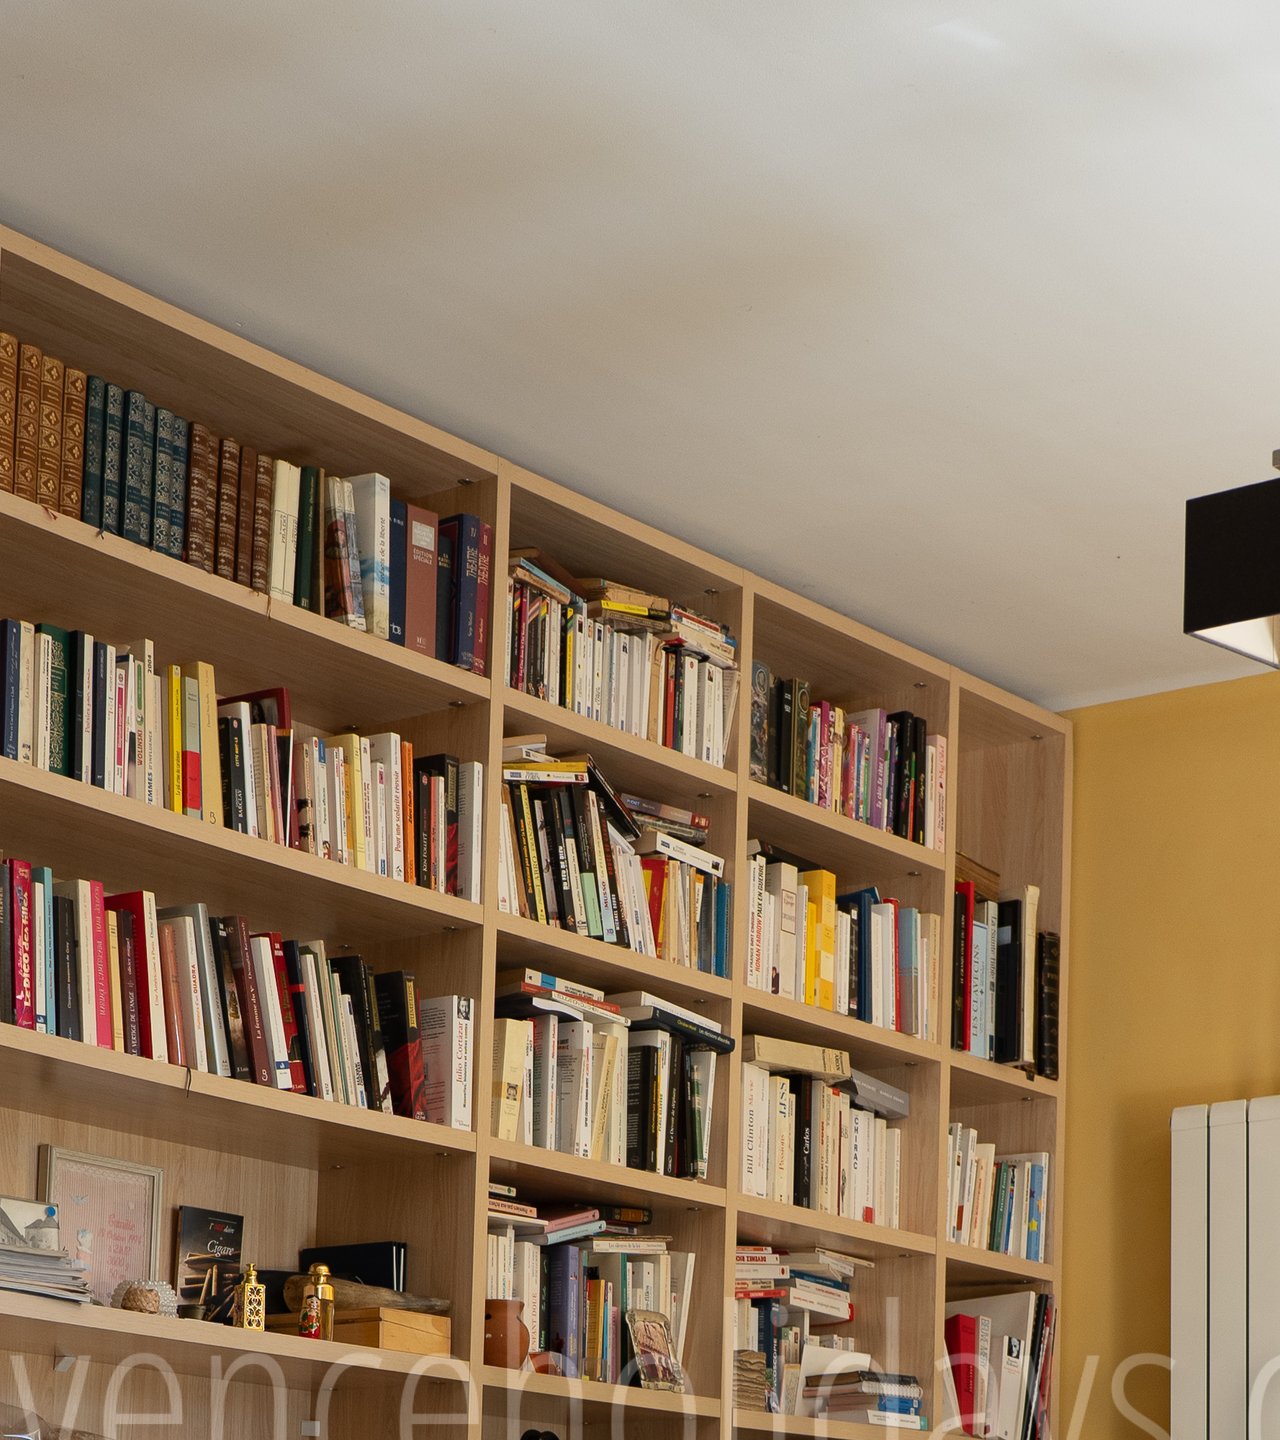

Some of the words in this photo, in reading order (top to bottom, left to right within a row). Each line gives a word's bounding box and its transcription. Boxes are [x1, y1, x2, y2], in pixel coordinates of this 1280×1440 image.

[136, 730, 144, 766] WOLINSKI
[602, 880, 610, 908] MUSSO
[754, 948, 762, 972] RONAN
[972, 944, 981, 1010] CLAVECINS
[456, 1021, 464, 1060] Cortázar
[456, 1063, 464, 1083] Julio
[746, 1109, 755, 1151] Clinton
[802, 1127, 810, 1154] Carlos
[852, 1116, 860, 1170] CHIRAC
[746, 1154, 754, 1174] Bill
